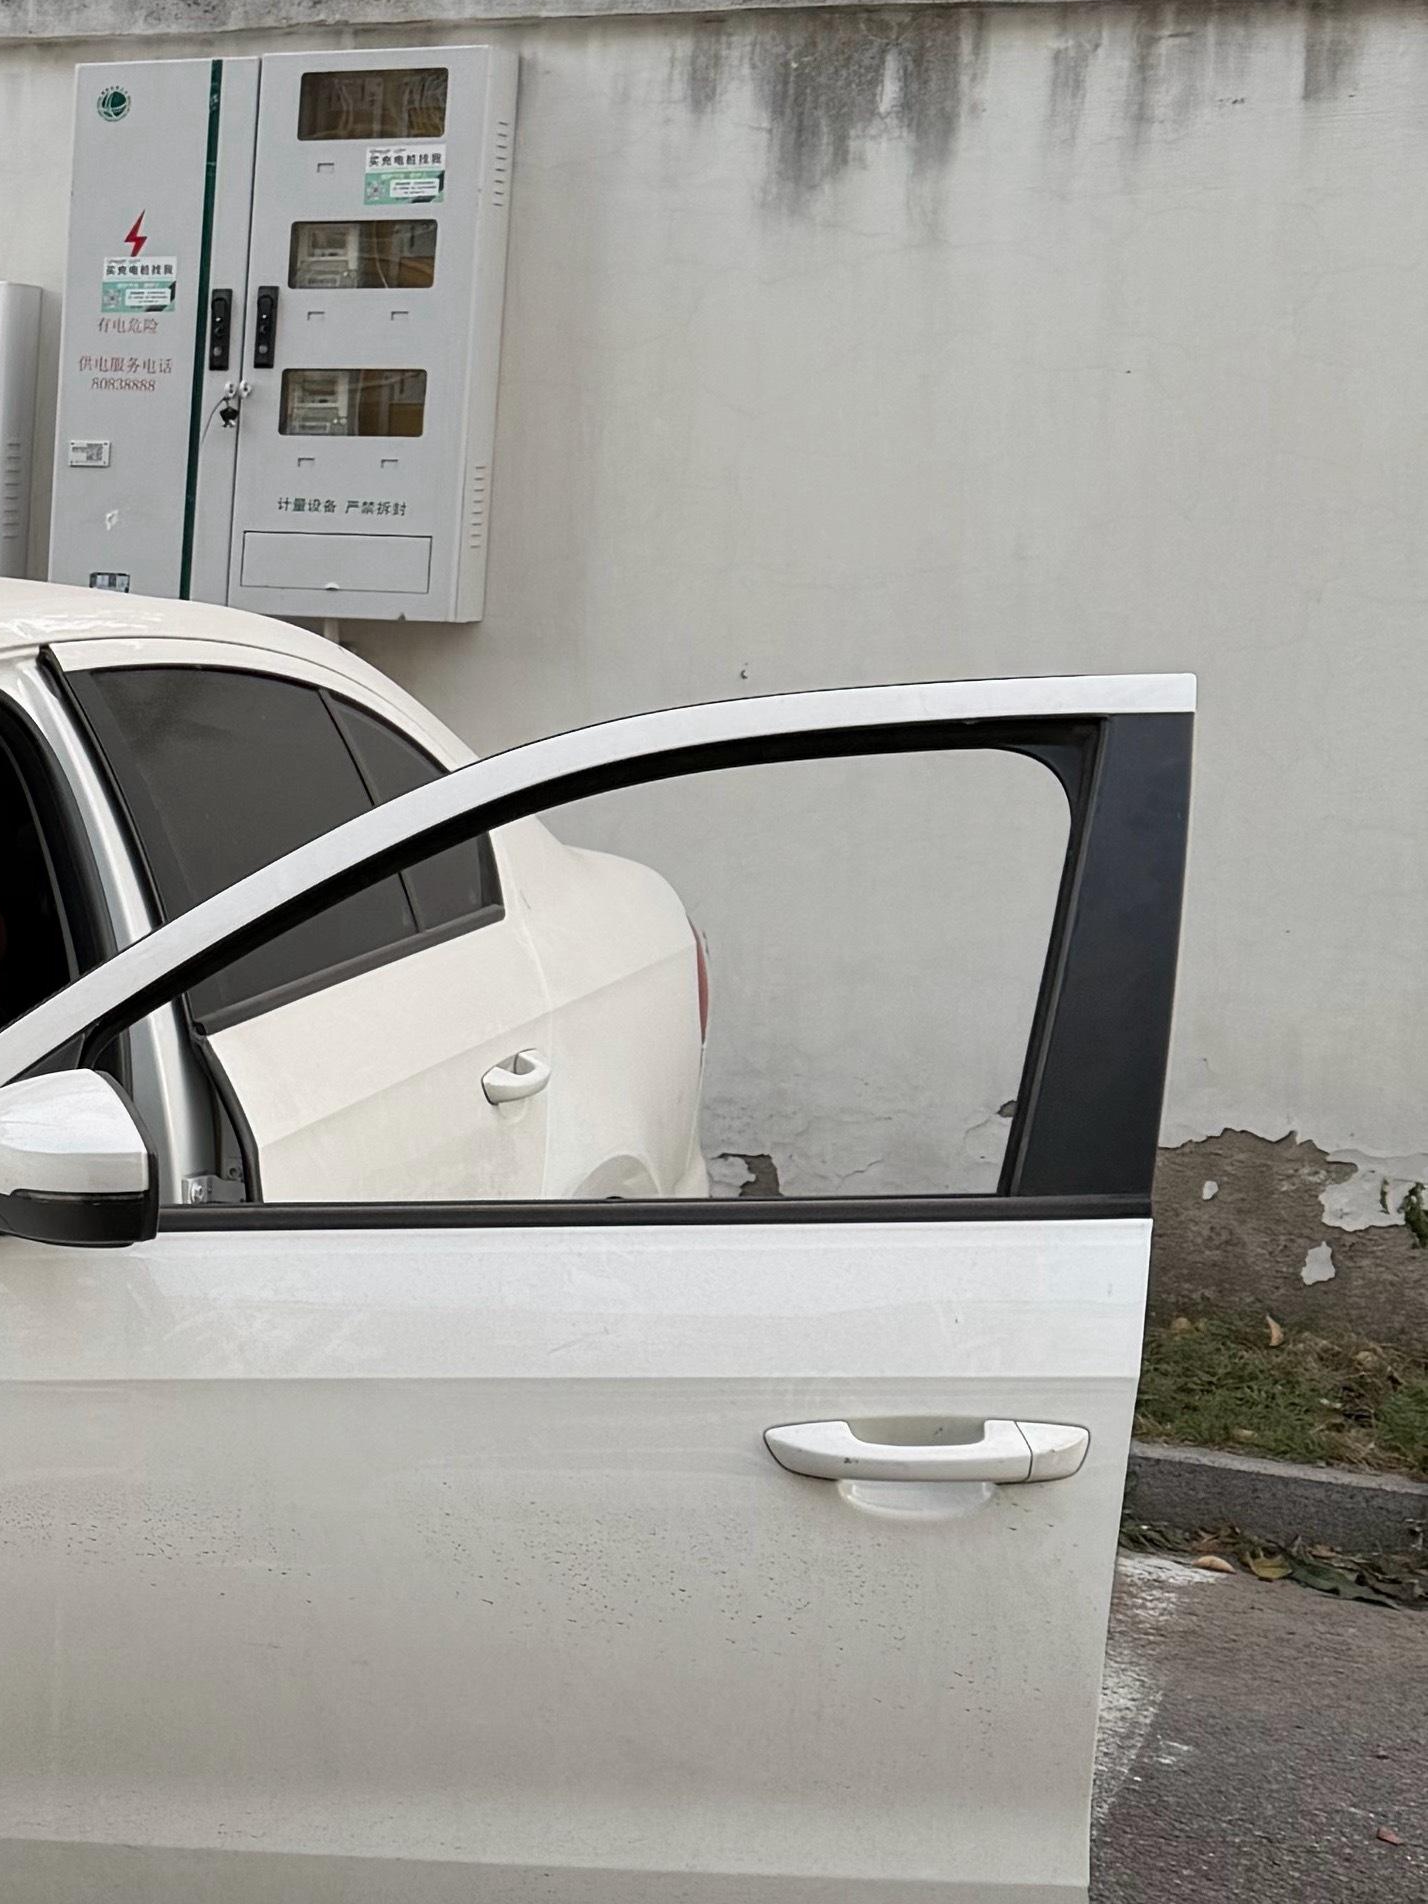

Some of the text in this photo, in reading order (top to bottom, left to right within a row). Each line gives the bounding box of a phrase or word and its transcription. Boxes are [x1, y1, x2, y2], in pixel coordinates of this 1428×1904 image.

[98, 317, 159, 334] 有电危险
[78, 355, 172, 374] 供电服务电话
[91, 377, 156, 392] 80838888
[277, 497, 407, 516] 计量设备 严禁拆封
